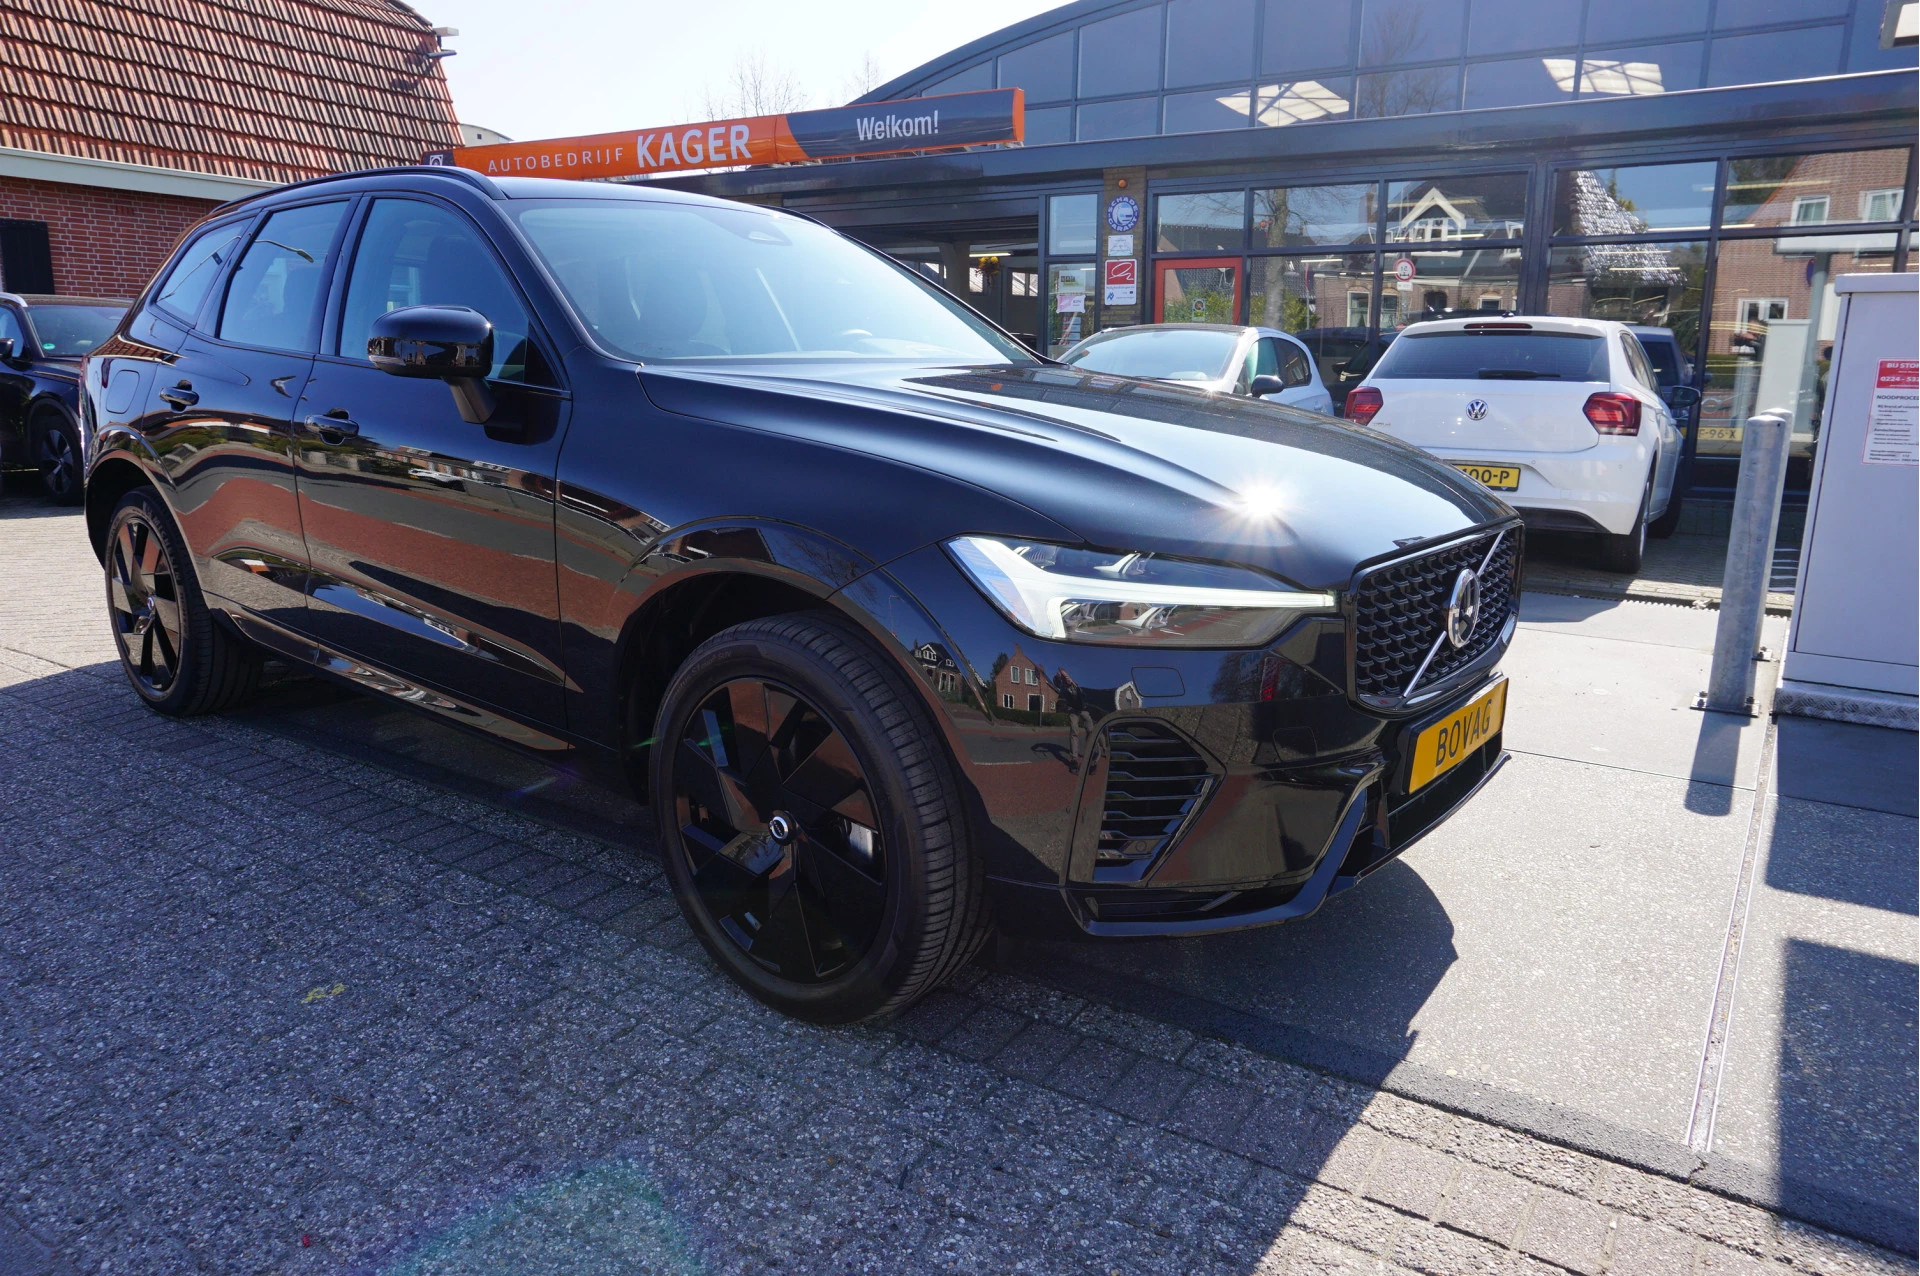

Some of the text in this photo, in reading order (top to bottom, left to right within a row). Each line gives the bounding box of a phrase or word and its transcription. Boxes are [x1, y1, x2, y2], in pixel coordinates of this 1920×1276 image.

[488, 124, 752, 173] AUTOBEDRIJF KAGER
[856, 110, 939, 141] Welkom!
[1435, 698, 1493, 768] BOVAG
